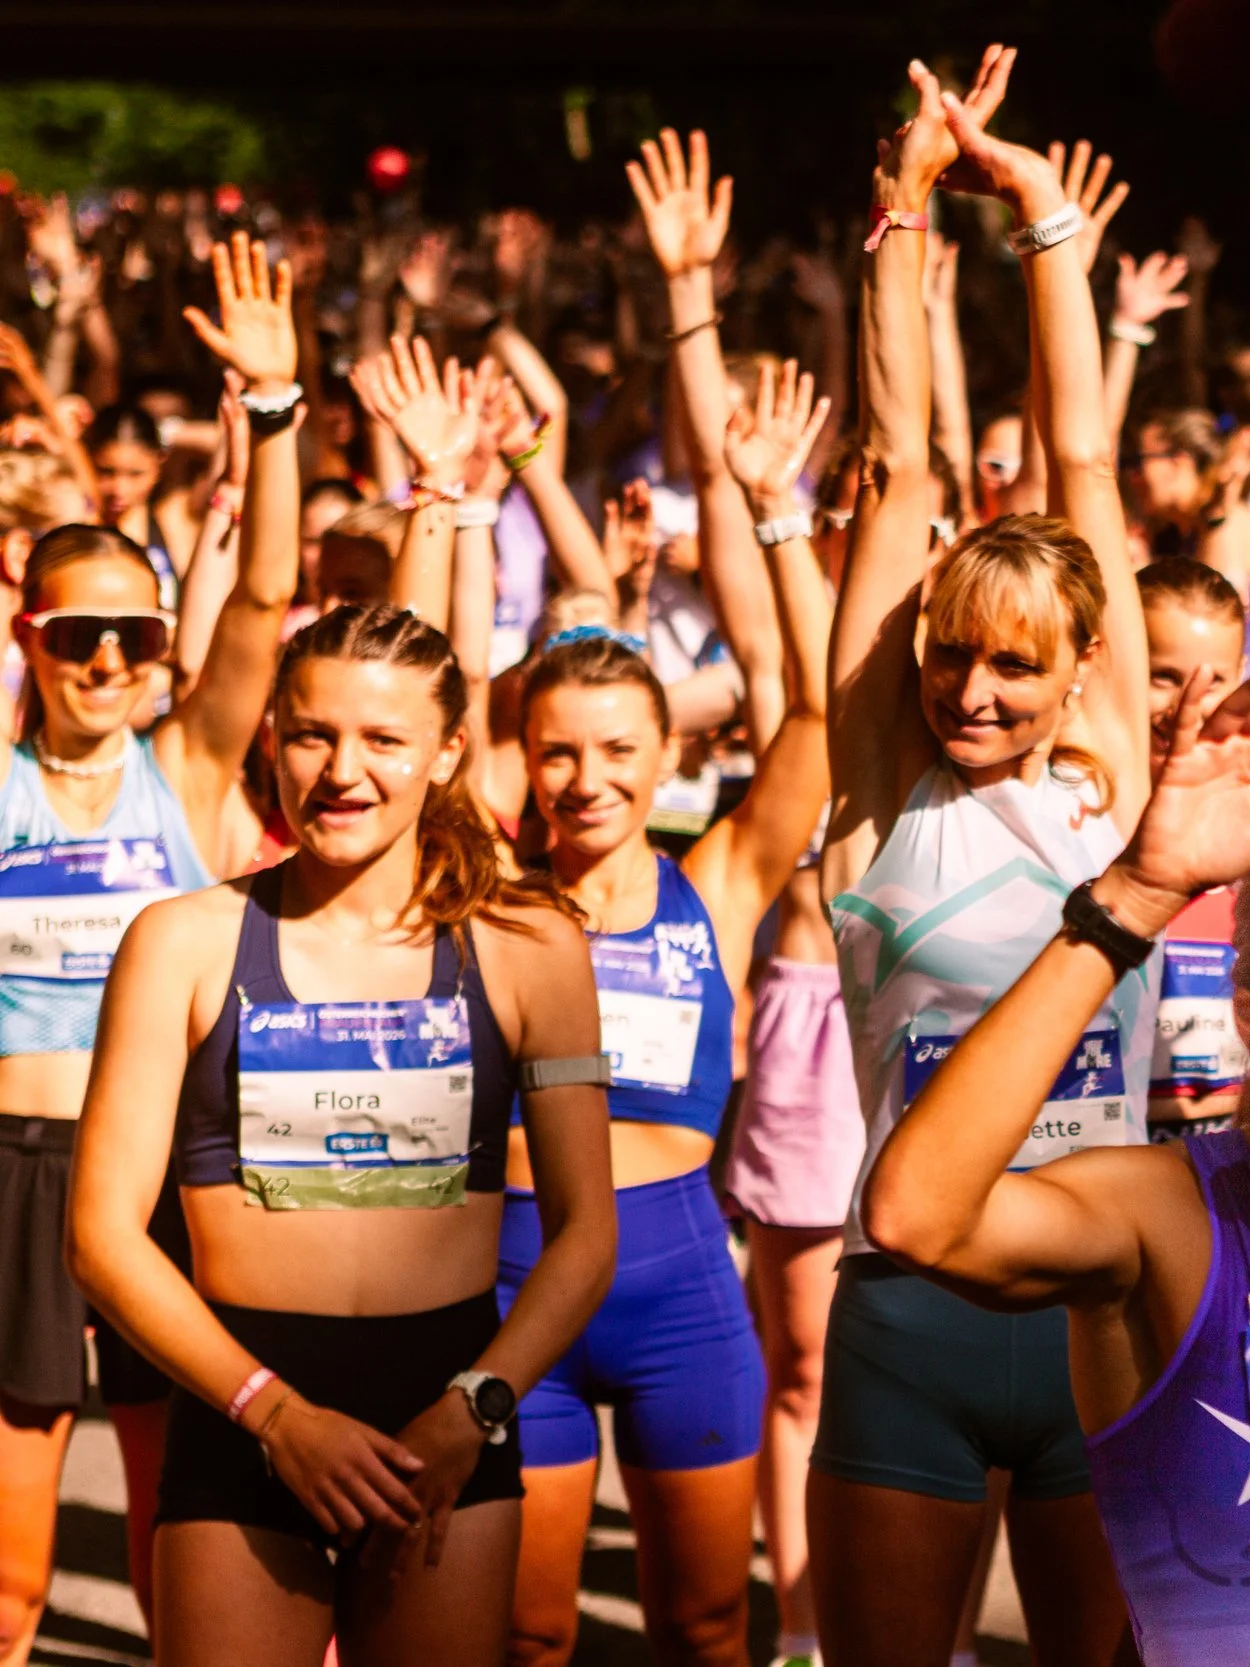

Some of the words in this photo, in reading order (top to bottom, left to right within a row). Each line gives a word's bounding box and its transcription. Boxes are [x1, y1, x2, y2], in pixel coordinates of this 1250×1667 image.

[33, 914, 121, 934] Theresa
[314, 1091, 381, 1111] Flora
[266, 1123, 293, 1138] 42
